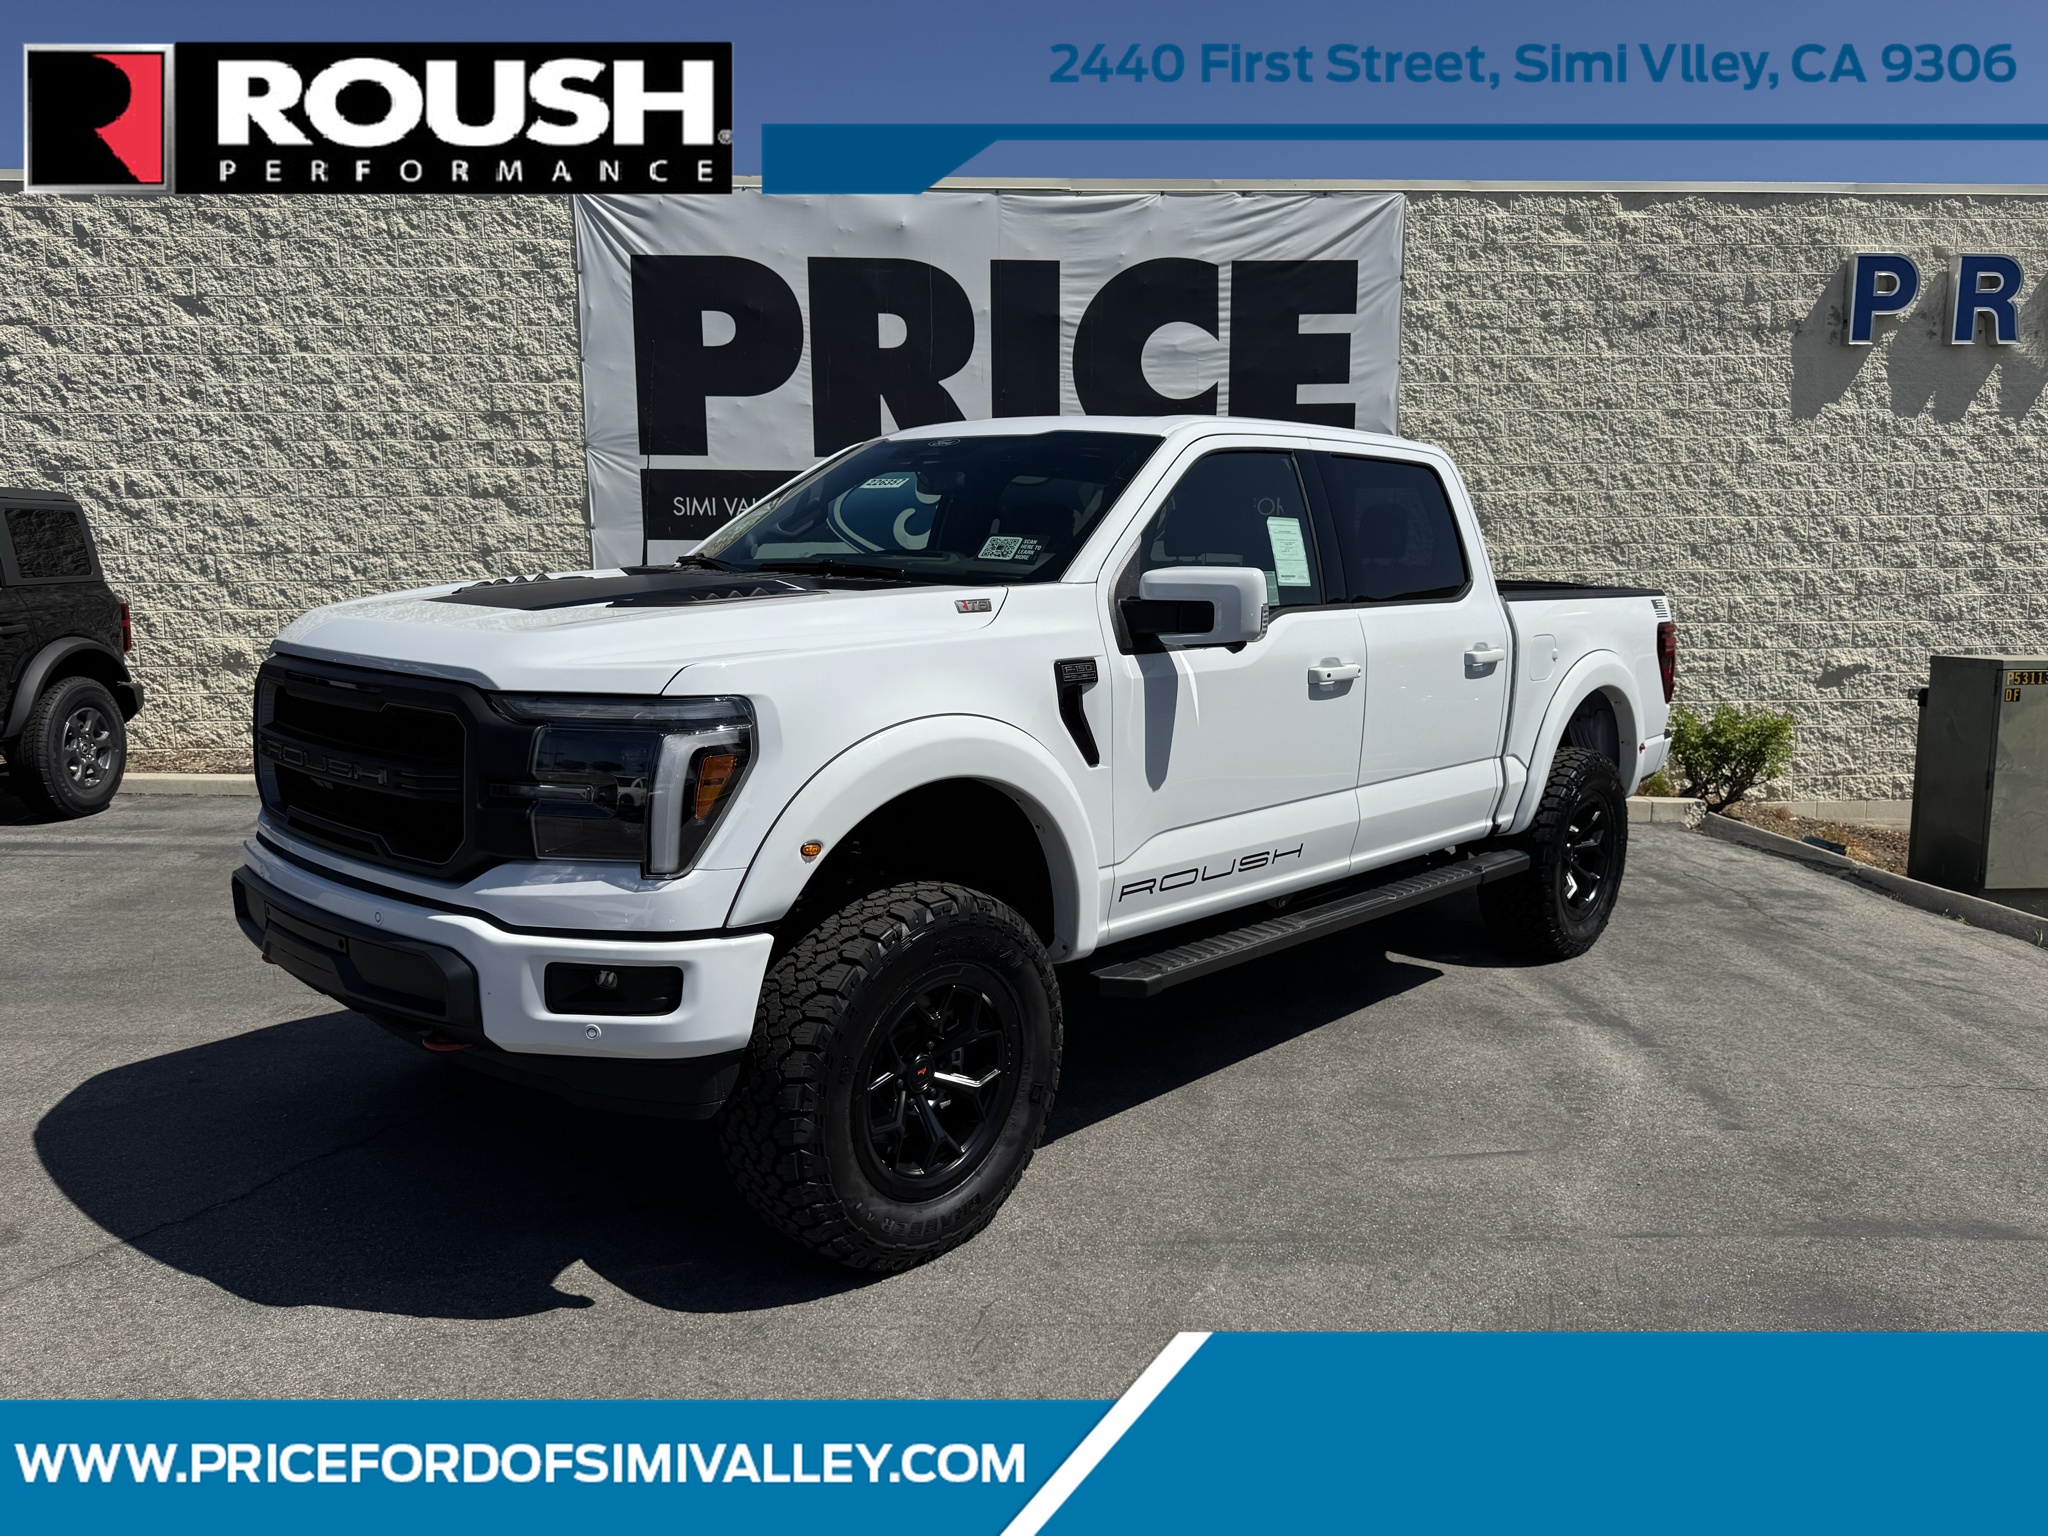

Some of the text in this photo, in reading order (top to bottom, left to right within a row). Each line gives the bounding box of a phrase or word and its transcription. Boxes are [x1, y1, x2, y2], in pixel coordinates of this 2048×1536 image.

[631, 254, 1358, 457] PRICE
[673, 496, 716, 516] SIMI
[1064, 664, 1093, 673] F-150
[2005, 689, 2020, 702] DF
[266, 738, 388, 785] ROUSH
[1118, 842, 1304, 903] ROUSH
[879, 1192, 982, 1238] GRABBER
